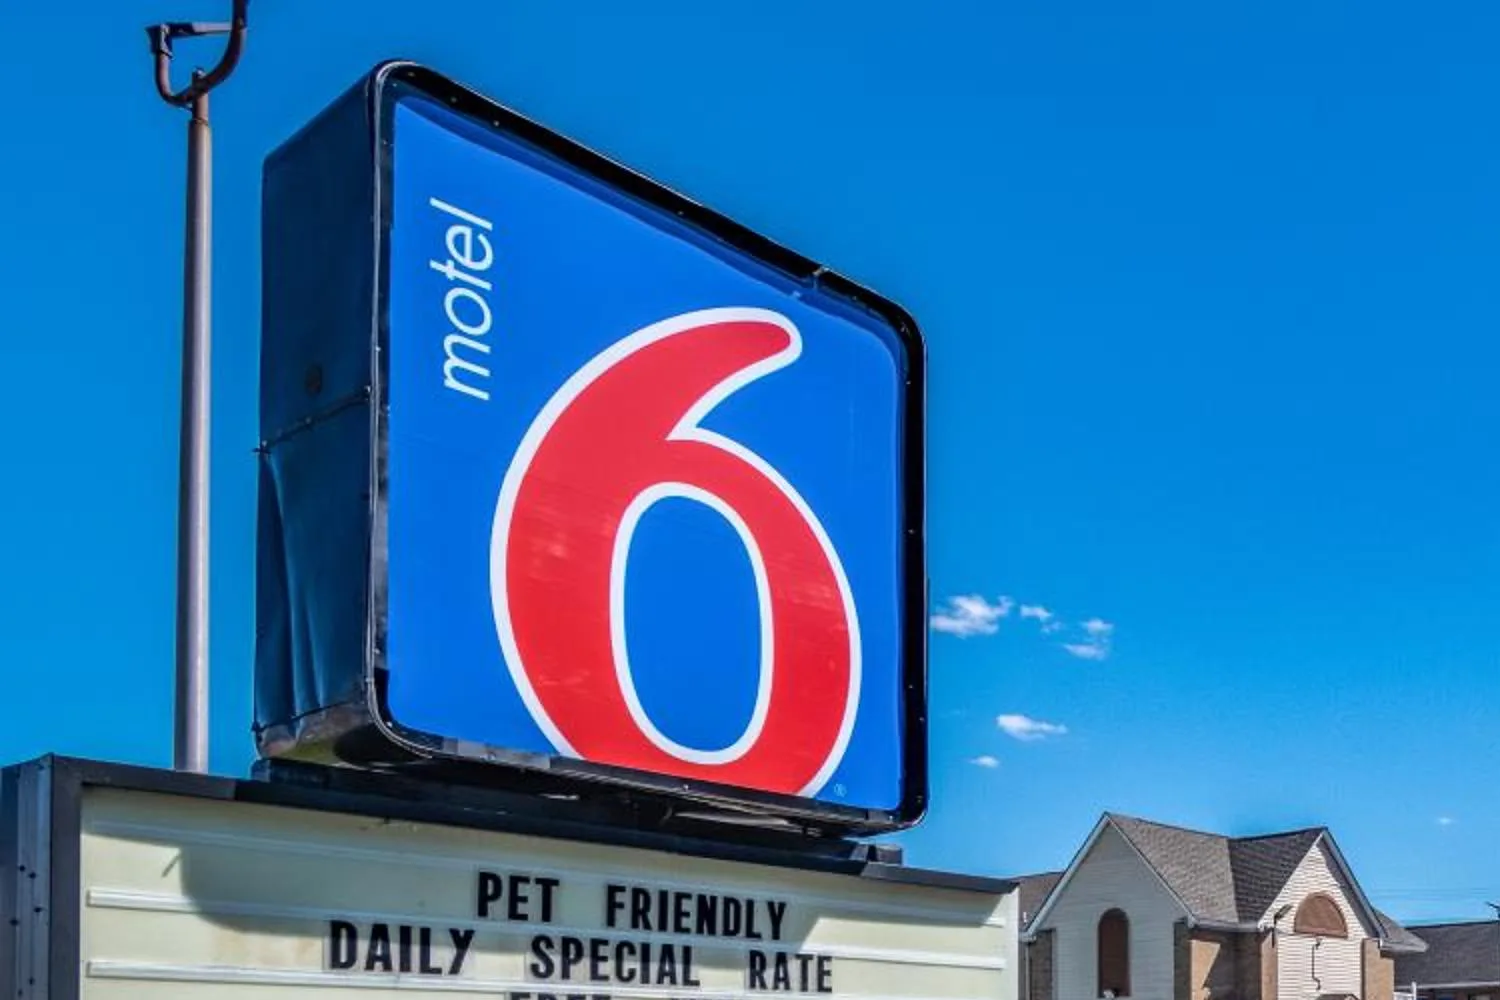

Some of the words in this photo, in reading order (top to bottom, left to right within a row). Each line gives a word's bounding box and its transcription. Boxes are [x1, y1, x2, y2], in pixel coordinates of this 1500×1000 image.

[430, 197, 494, 400] motel
[490, 306, 862, 799] 6
[330, 919, 475, 975] DAILY
[530, 934, 701, 986] SPECIAL
[749, 950, 833, 993] RATE
[477, 871, 560, 922] PET
[606, 884, 787, 941] FRIENDLY
